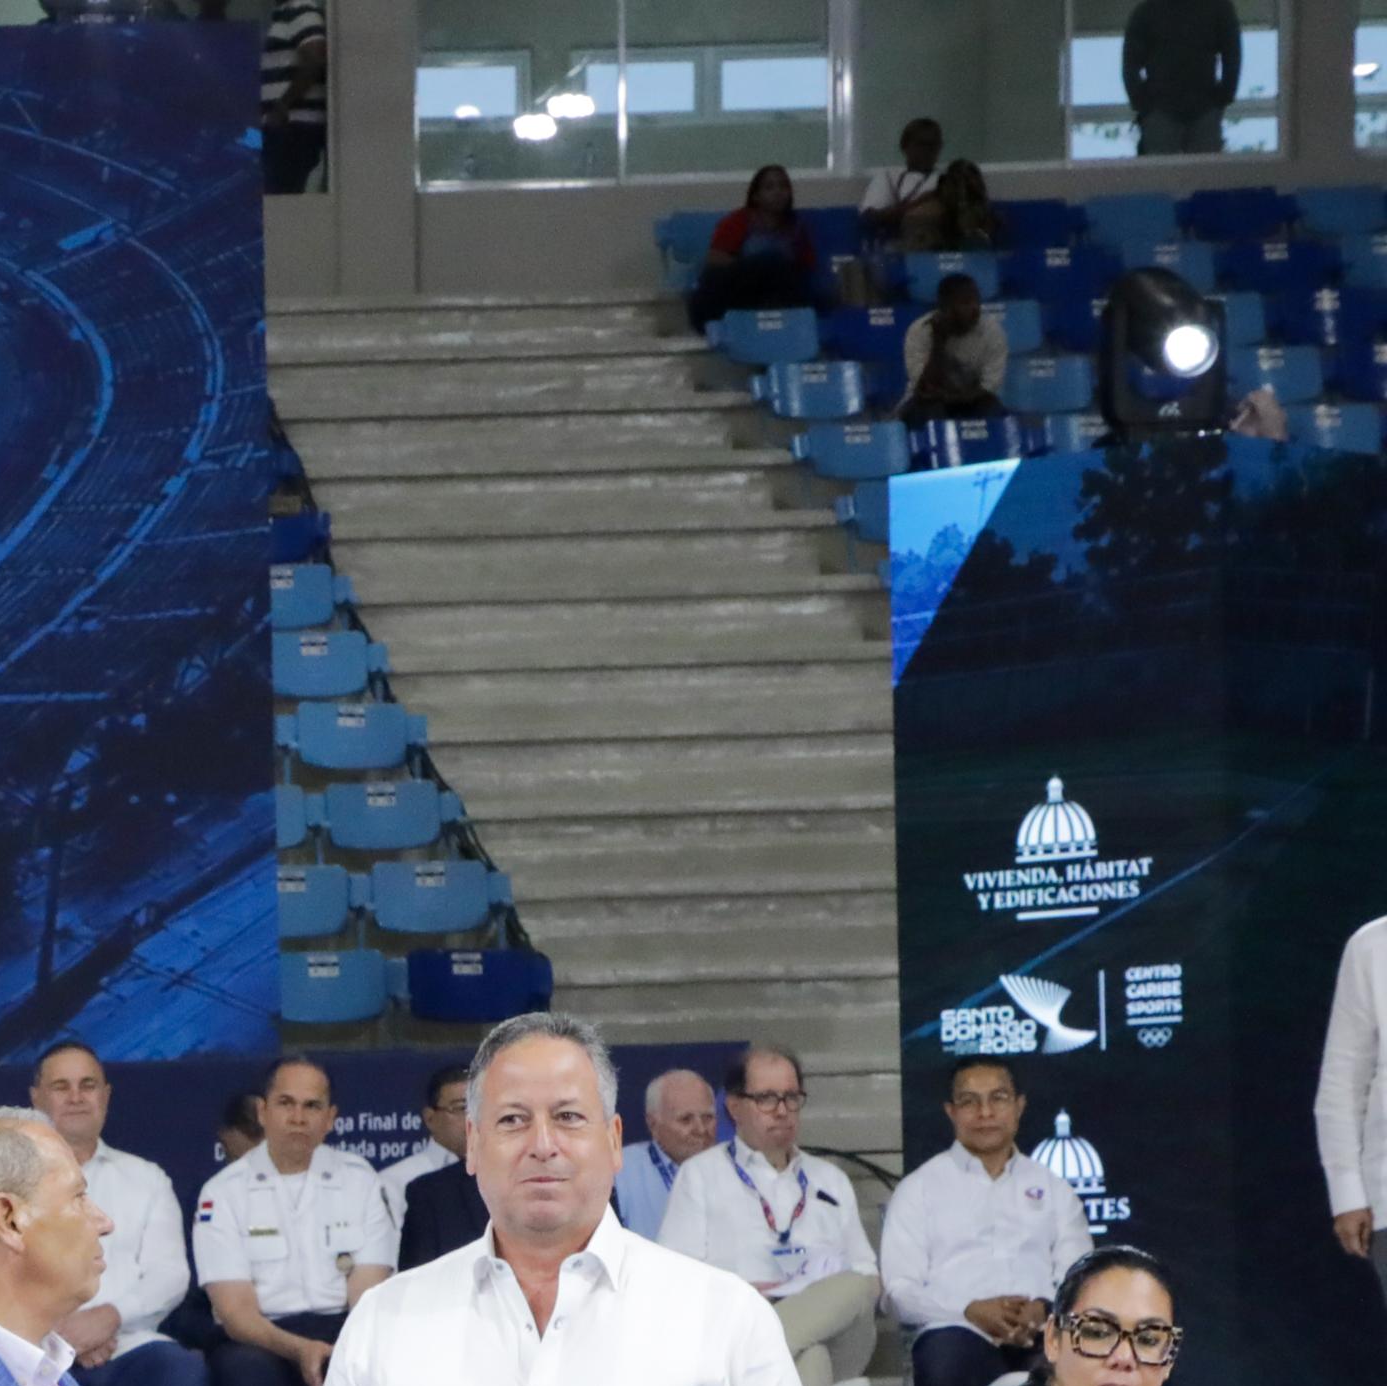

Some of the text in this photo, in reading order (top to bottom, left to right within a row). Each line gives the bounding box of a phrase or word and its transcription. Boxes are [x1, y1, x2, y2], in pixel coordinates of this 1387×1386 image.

[964, 857, 1152, 890] VIVIENDA, HÁBITAT
[978, 881, 1139, 910] Y EDIFICACIONES
[1126, 964, 1182, 981] CENTRO
[1126, 980, 1182, 999] CARIBE
[940, 1005, 1014, 1024] SANTO
[1127, 999, 1182, 1015] SPORTS
[941, 1020, 1036, 1042] DOMINGO
[979, 1037, 1037, 1054] 2026
[359, 1112, 397, 1131] Final
[401, 1112, 422, 1130] de
[380, 1142, 408, 1161] por
